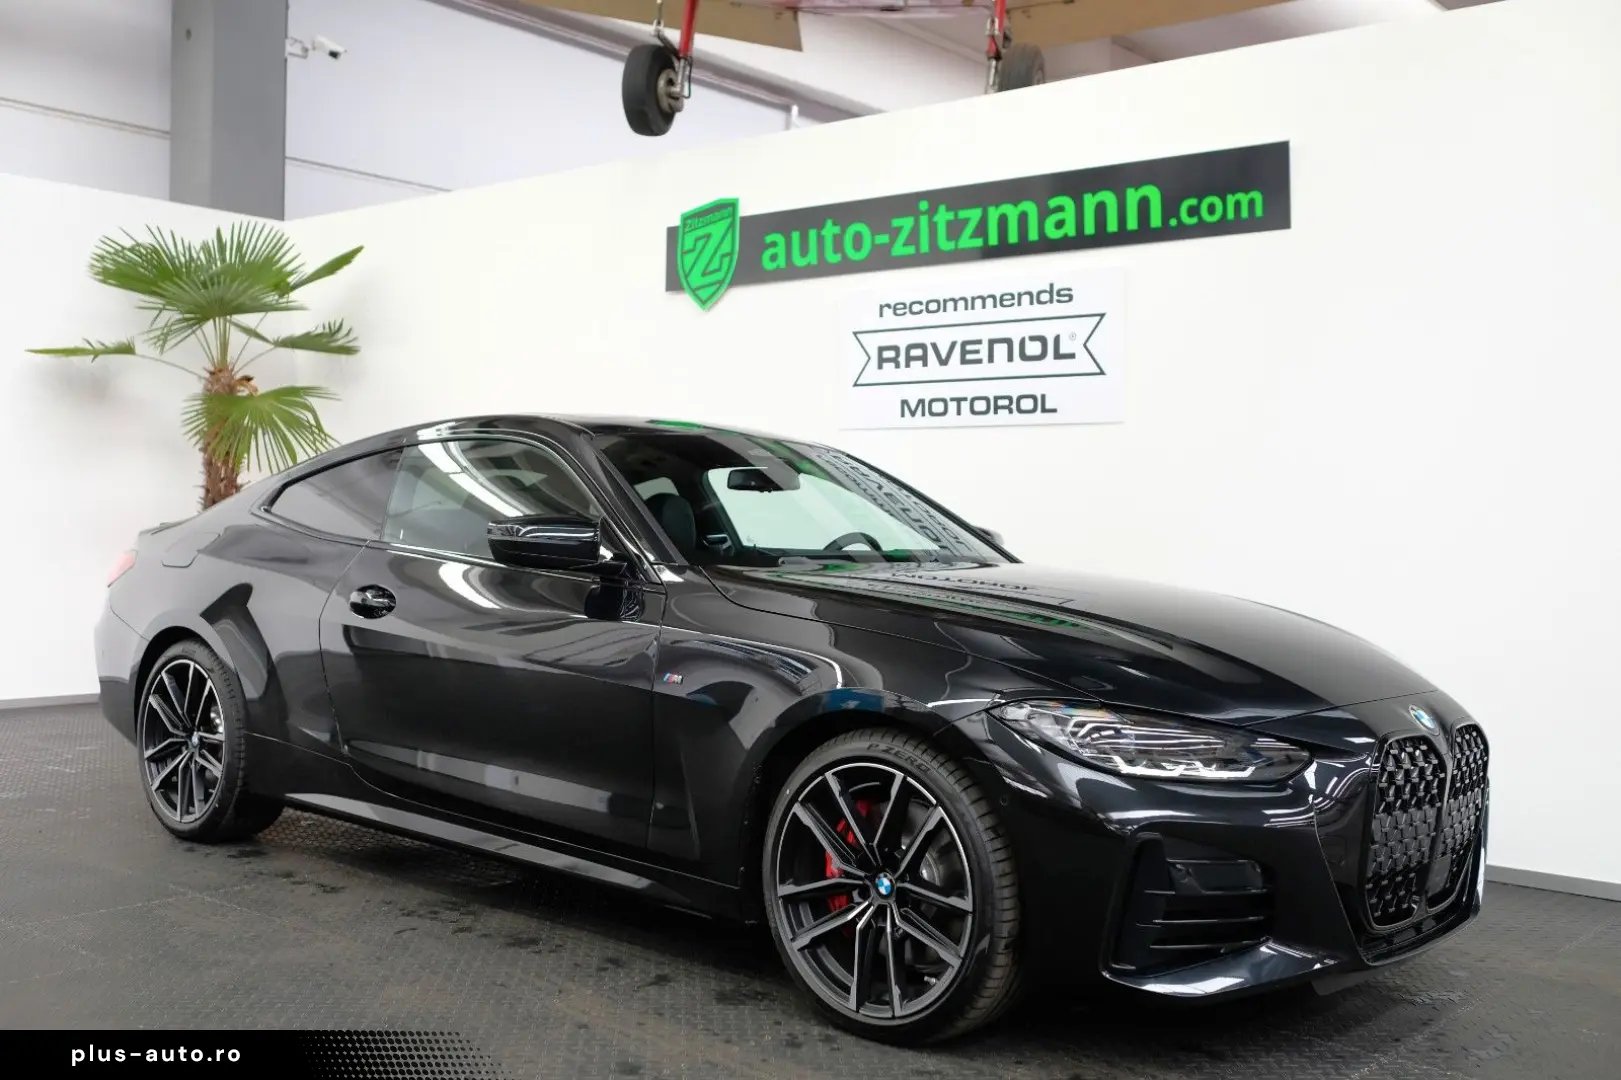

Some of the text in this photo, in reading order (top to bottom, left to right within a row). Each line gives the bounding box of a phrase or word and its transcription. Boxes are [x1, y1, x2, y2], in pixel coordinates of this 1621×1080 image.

[879, 282, 1074, 318] recommends
[877, 334, 1076, 370] RAVENOL
[900, 393, 1058, 418] MOTOROL
